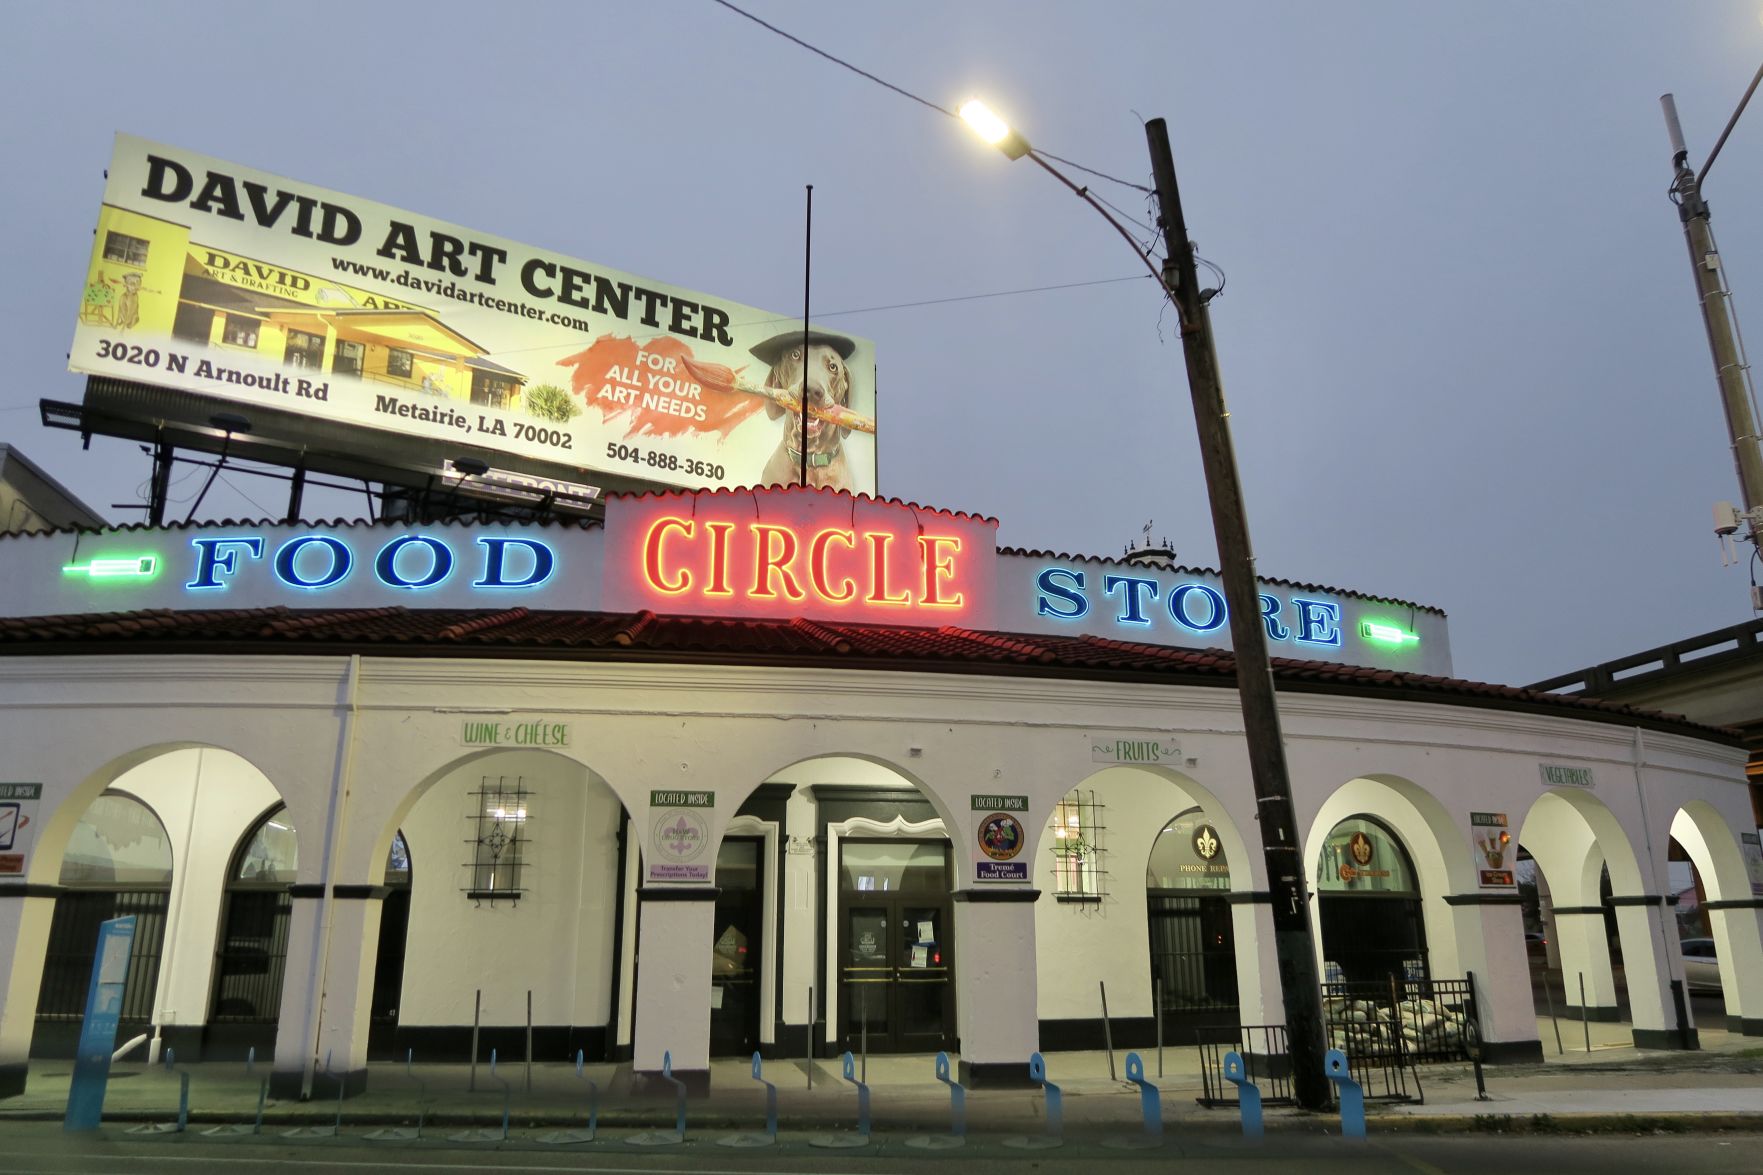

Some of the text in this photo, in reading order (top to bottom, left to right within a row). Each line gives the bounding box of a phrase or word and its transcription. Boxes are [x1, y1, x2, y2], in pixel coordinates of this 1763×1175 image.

[141, 153, 734, 347] DAVID ART CENTER
[202, 268, 227, 280] ART
[241, 276, 299, 298] DRAFTING
[203, 251, 311, 291] DAVID
[331, 256, 589, 333] www.davidartcenter.com
[95, 338, 330, 402] 3020 N Arnoult Rd
[635, 350, 677, 375] FOR
[604, 364, 703, 401] ALL YOUR
[596, 383, 708, 422] ART NEEDS
[374, 394, 573, 450] Metairie, LA 70002
[606, 442, 726, 481] 504-888-3630
[185, 535, 556, 590] FOOD
[642, 515, 965, 608] CIRCLE
[1036, 567, 1342, 647] STORE
[464, 722, 502, 744] WINE
[1116, 740, 1160, 762] FRUITS
[655, 792, 709, 805] LOCATED INSIDE
[975, 797, 1024, 809] LOCATED INSIDE
[980, 870, 999, 878] Food
[989, 862, 1015, 871] Tremé
[1180, 864, 1207, 872] PHONE
